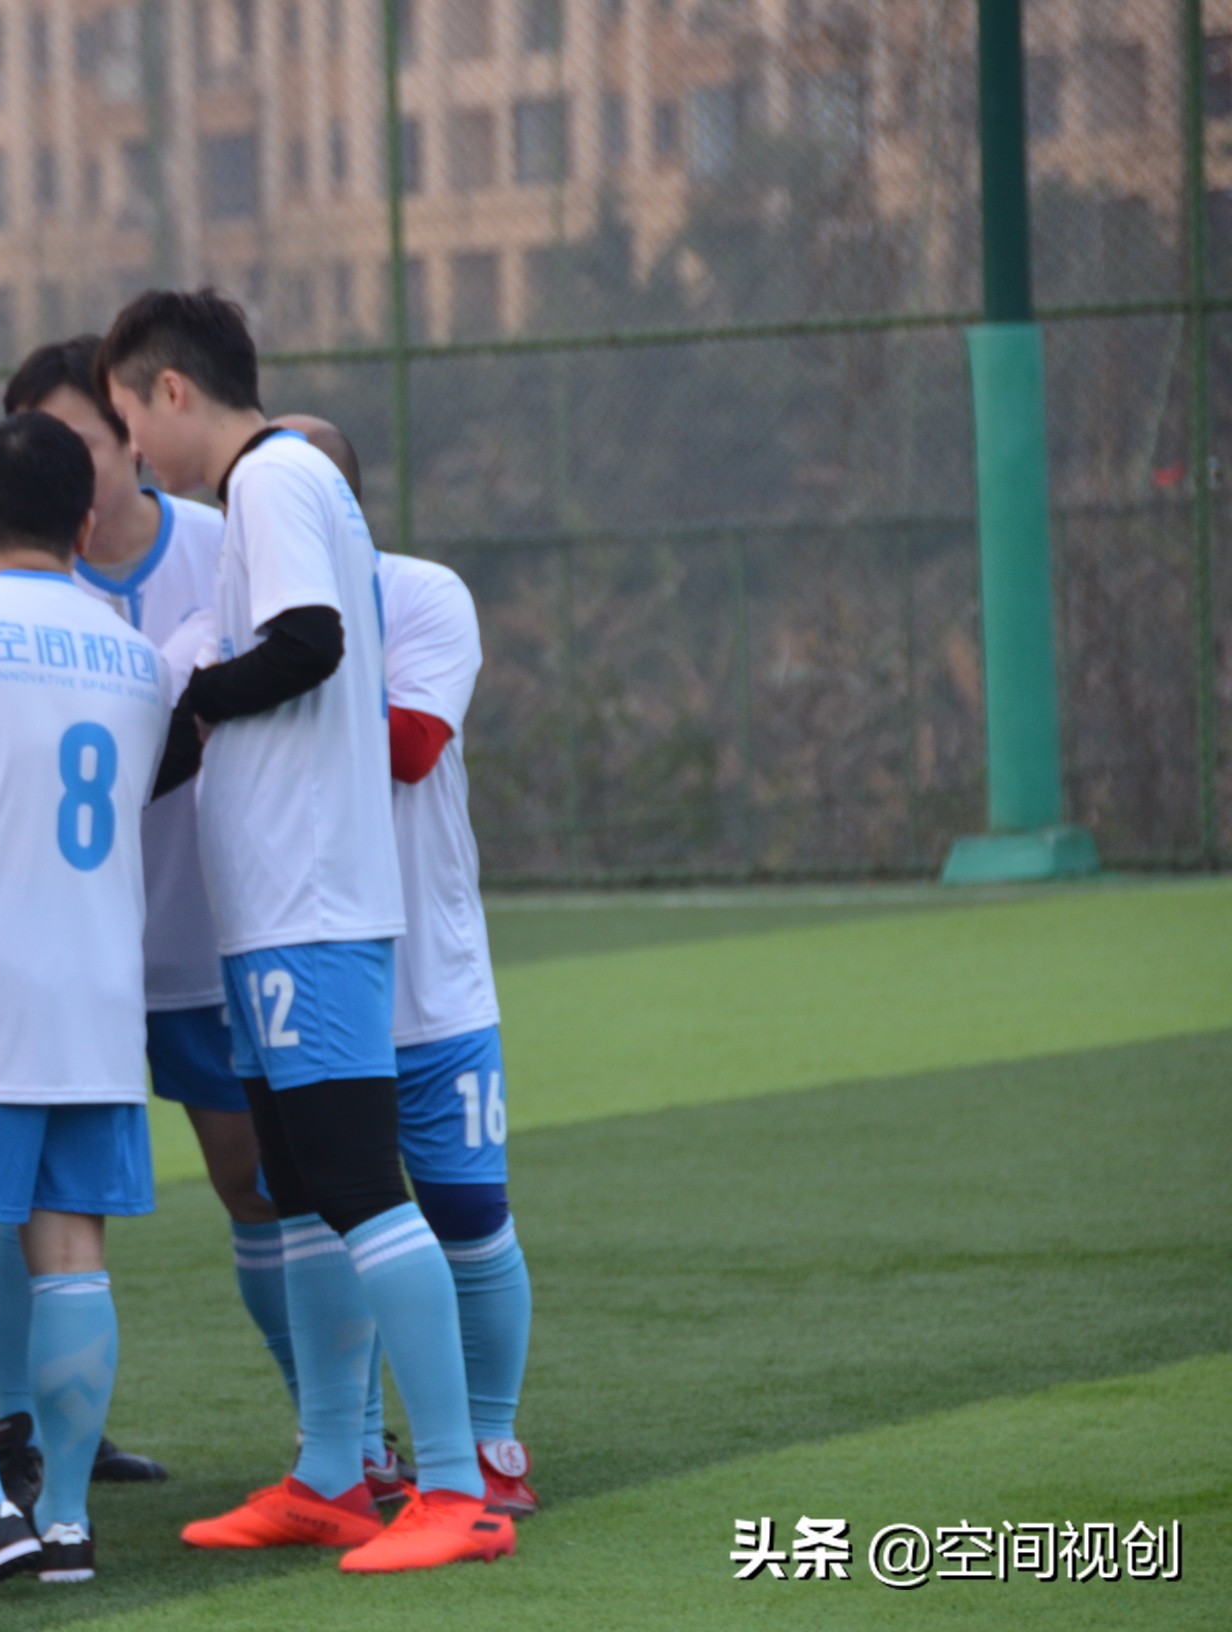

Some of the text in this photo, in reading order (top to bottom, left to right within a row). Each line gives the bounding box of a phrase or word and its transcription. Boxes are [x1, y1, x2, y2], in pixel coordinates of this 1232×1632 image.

[81, 678, 123, 695] SPACE
[57, 721, 118, 872] 8
[248, 969, 300, 1048] 12
[455, 1071, 508, 1148] 16
